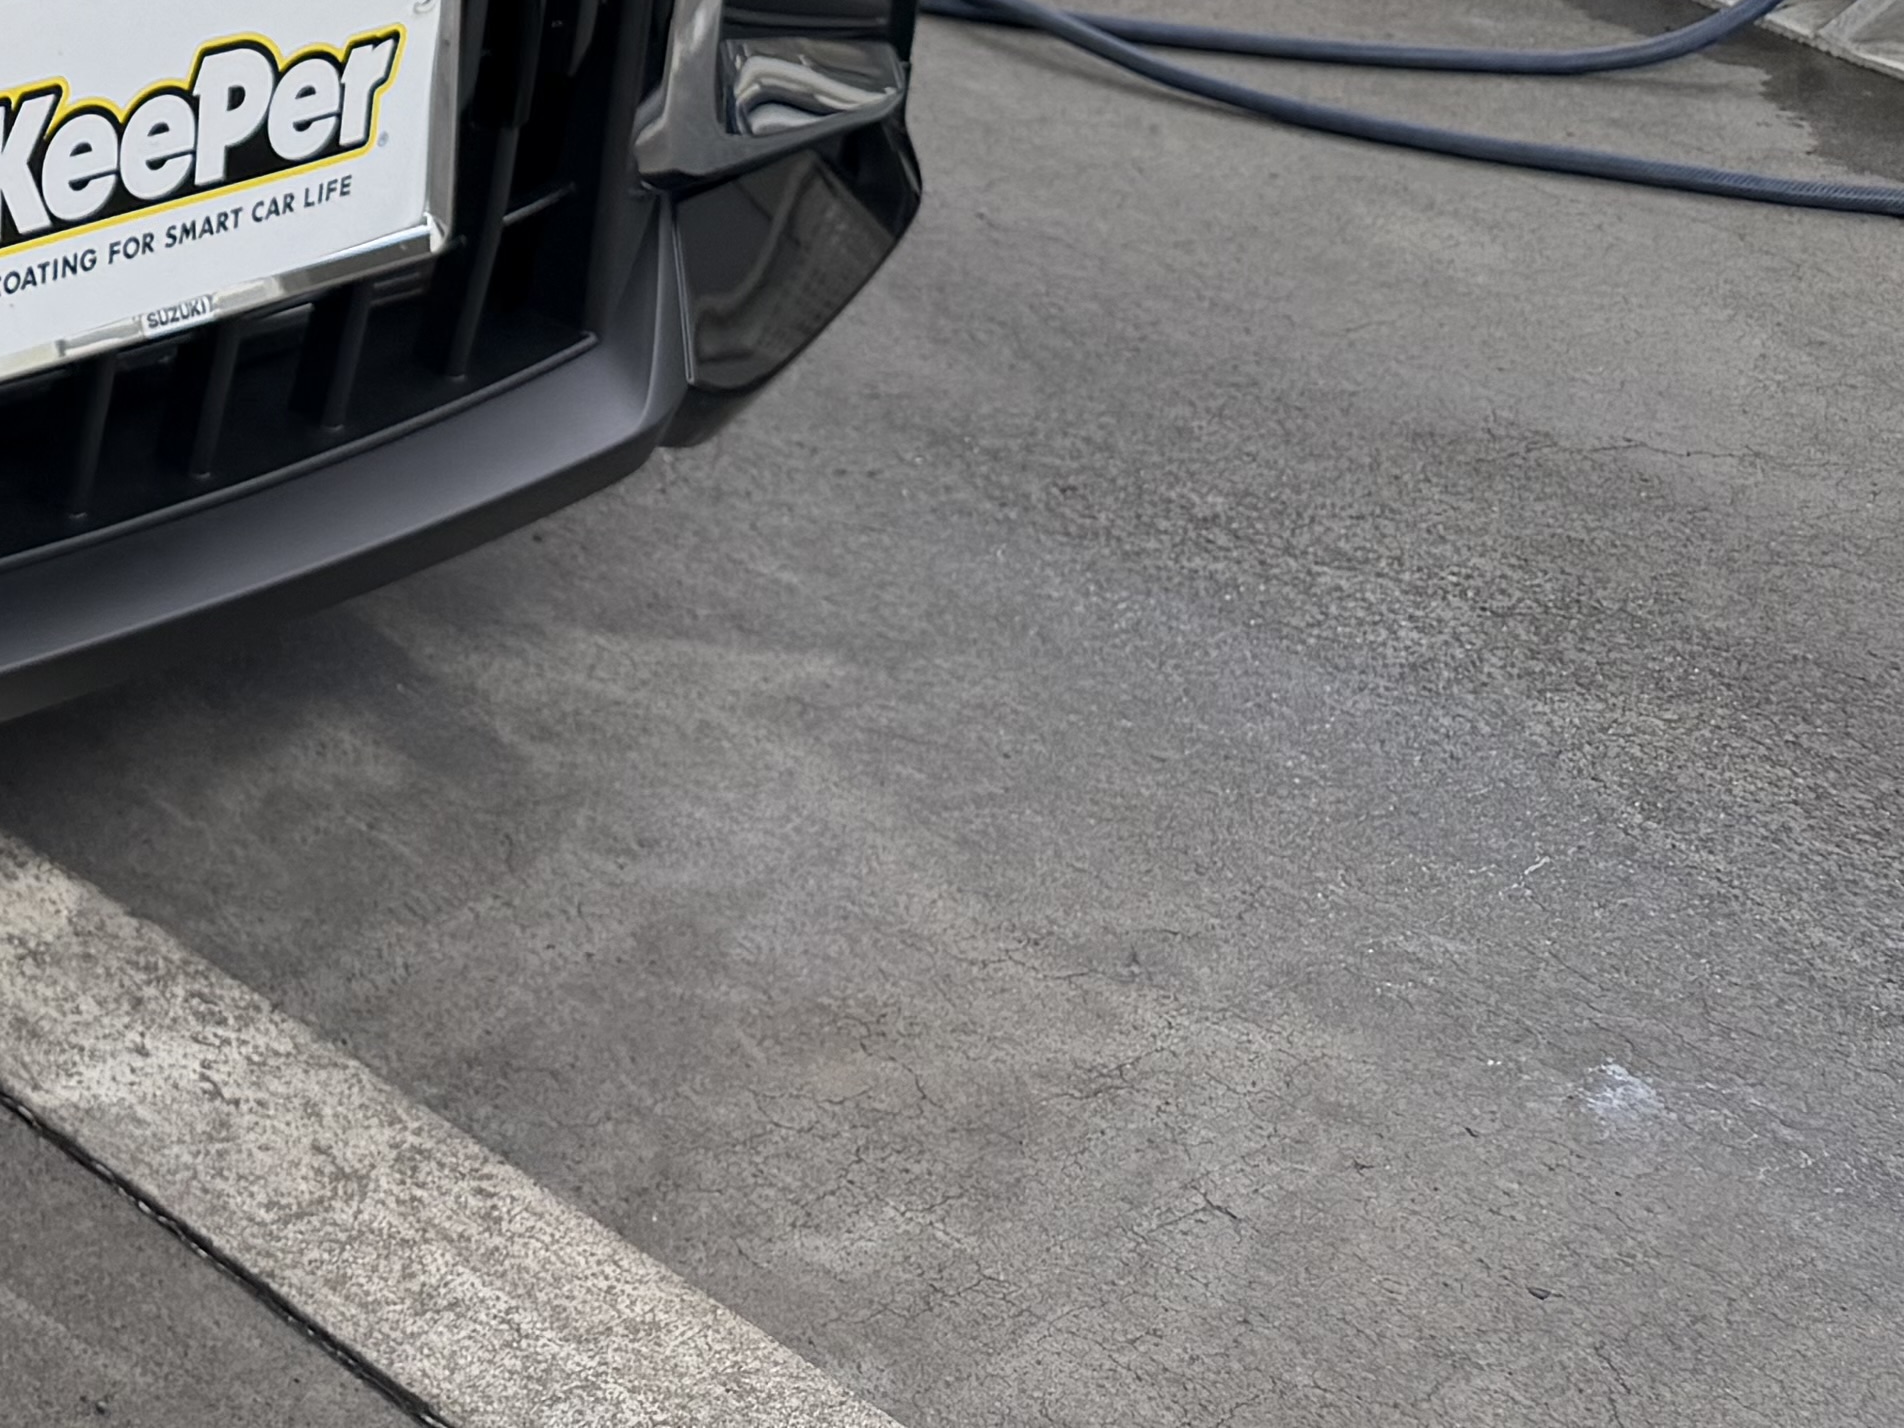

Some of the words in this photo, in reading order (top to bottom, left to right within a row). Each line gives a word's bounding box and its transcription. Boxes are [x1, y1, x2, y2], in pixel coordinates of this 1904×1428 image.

[108, 231, 156, 265] FOR
[164, 206, 244, 249] SMART
[251, 192, 296, 223] CAR
[303, 174, 354, 209] LIFE
[146, 296, 208, 329] SUZUKI
